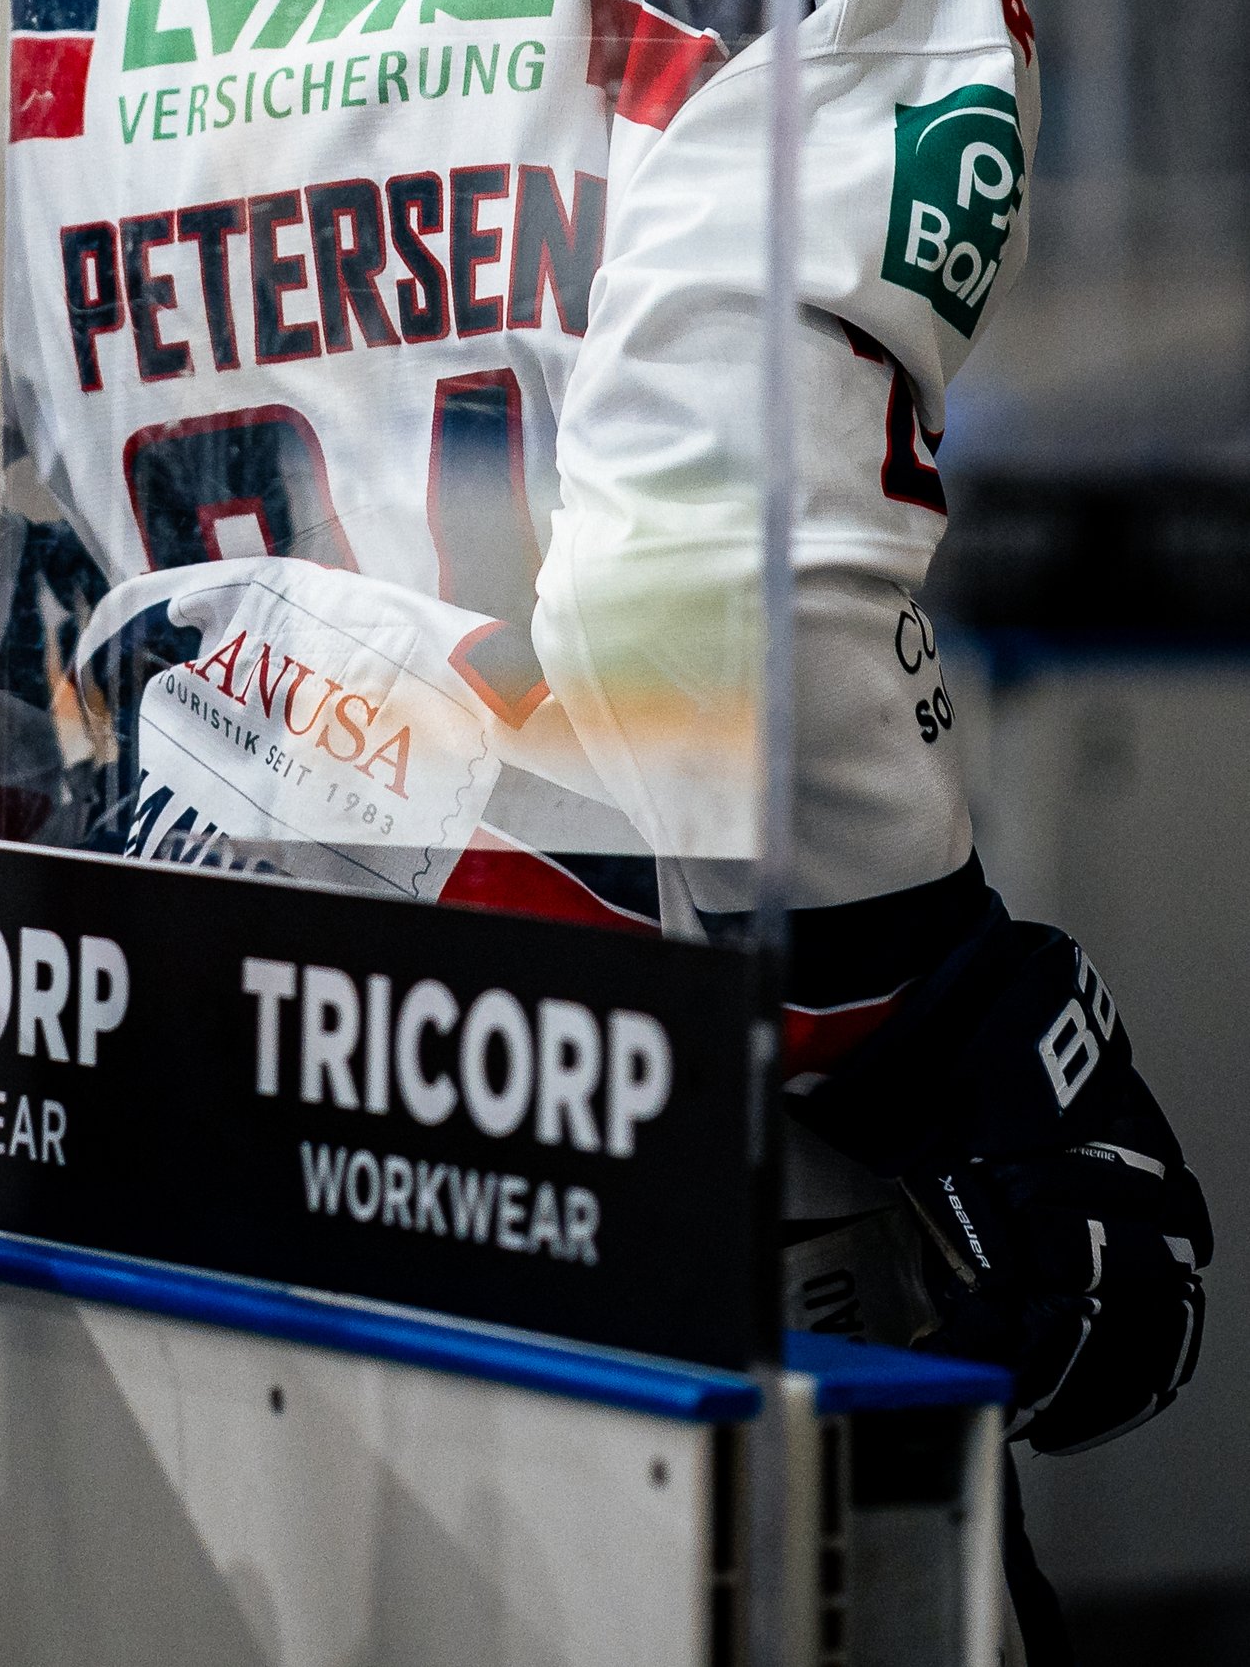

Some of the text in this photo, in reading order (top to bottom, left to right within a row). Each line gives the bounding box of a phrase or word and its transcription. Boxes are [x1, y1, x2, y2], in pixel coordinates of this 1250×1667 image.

[119, 39, 547, 145] VERSICHERUNG
[60, 163, 608, 393] PETERSEN
[184, 630, 409, 800] ANUSA
[265, 745, 312, 787] SEIT
[326, 783, 395, 836] 1983
[243, 957, 673, 1158] TRICORP
[300, 1141, 600, 1266] WORKWEAR
